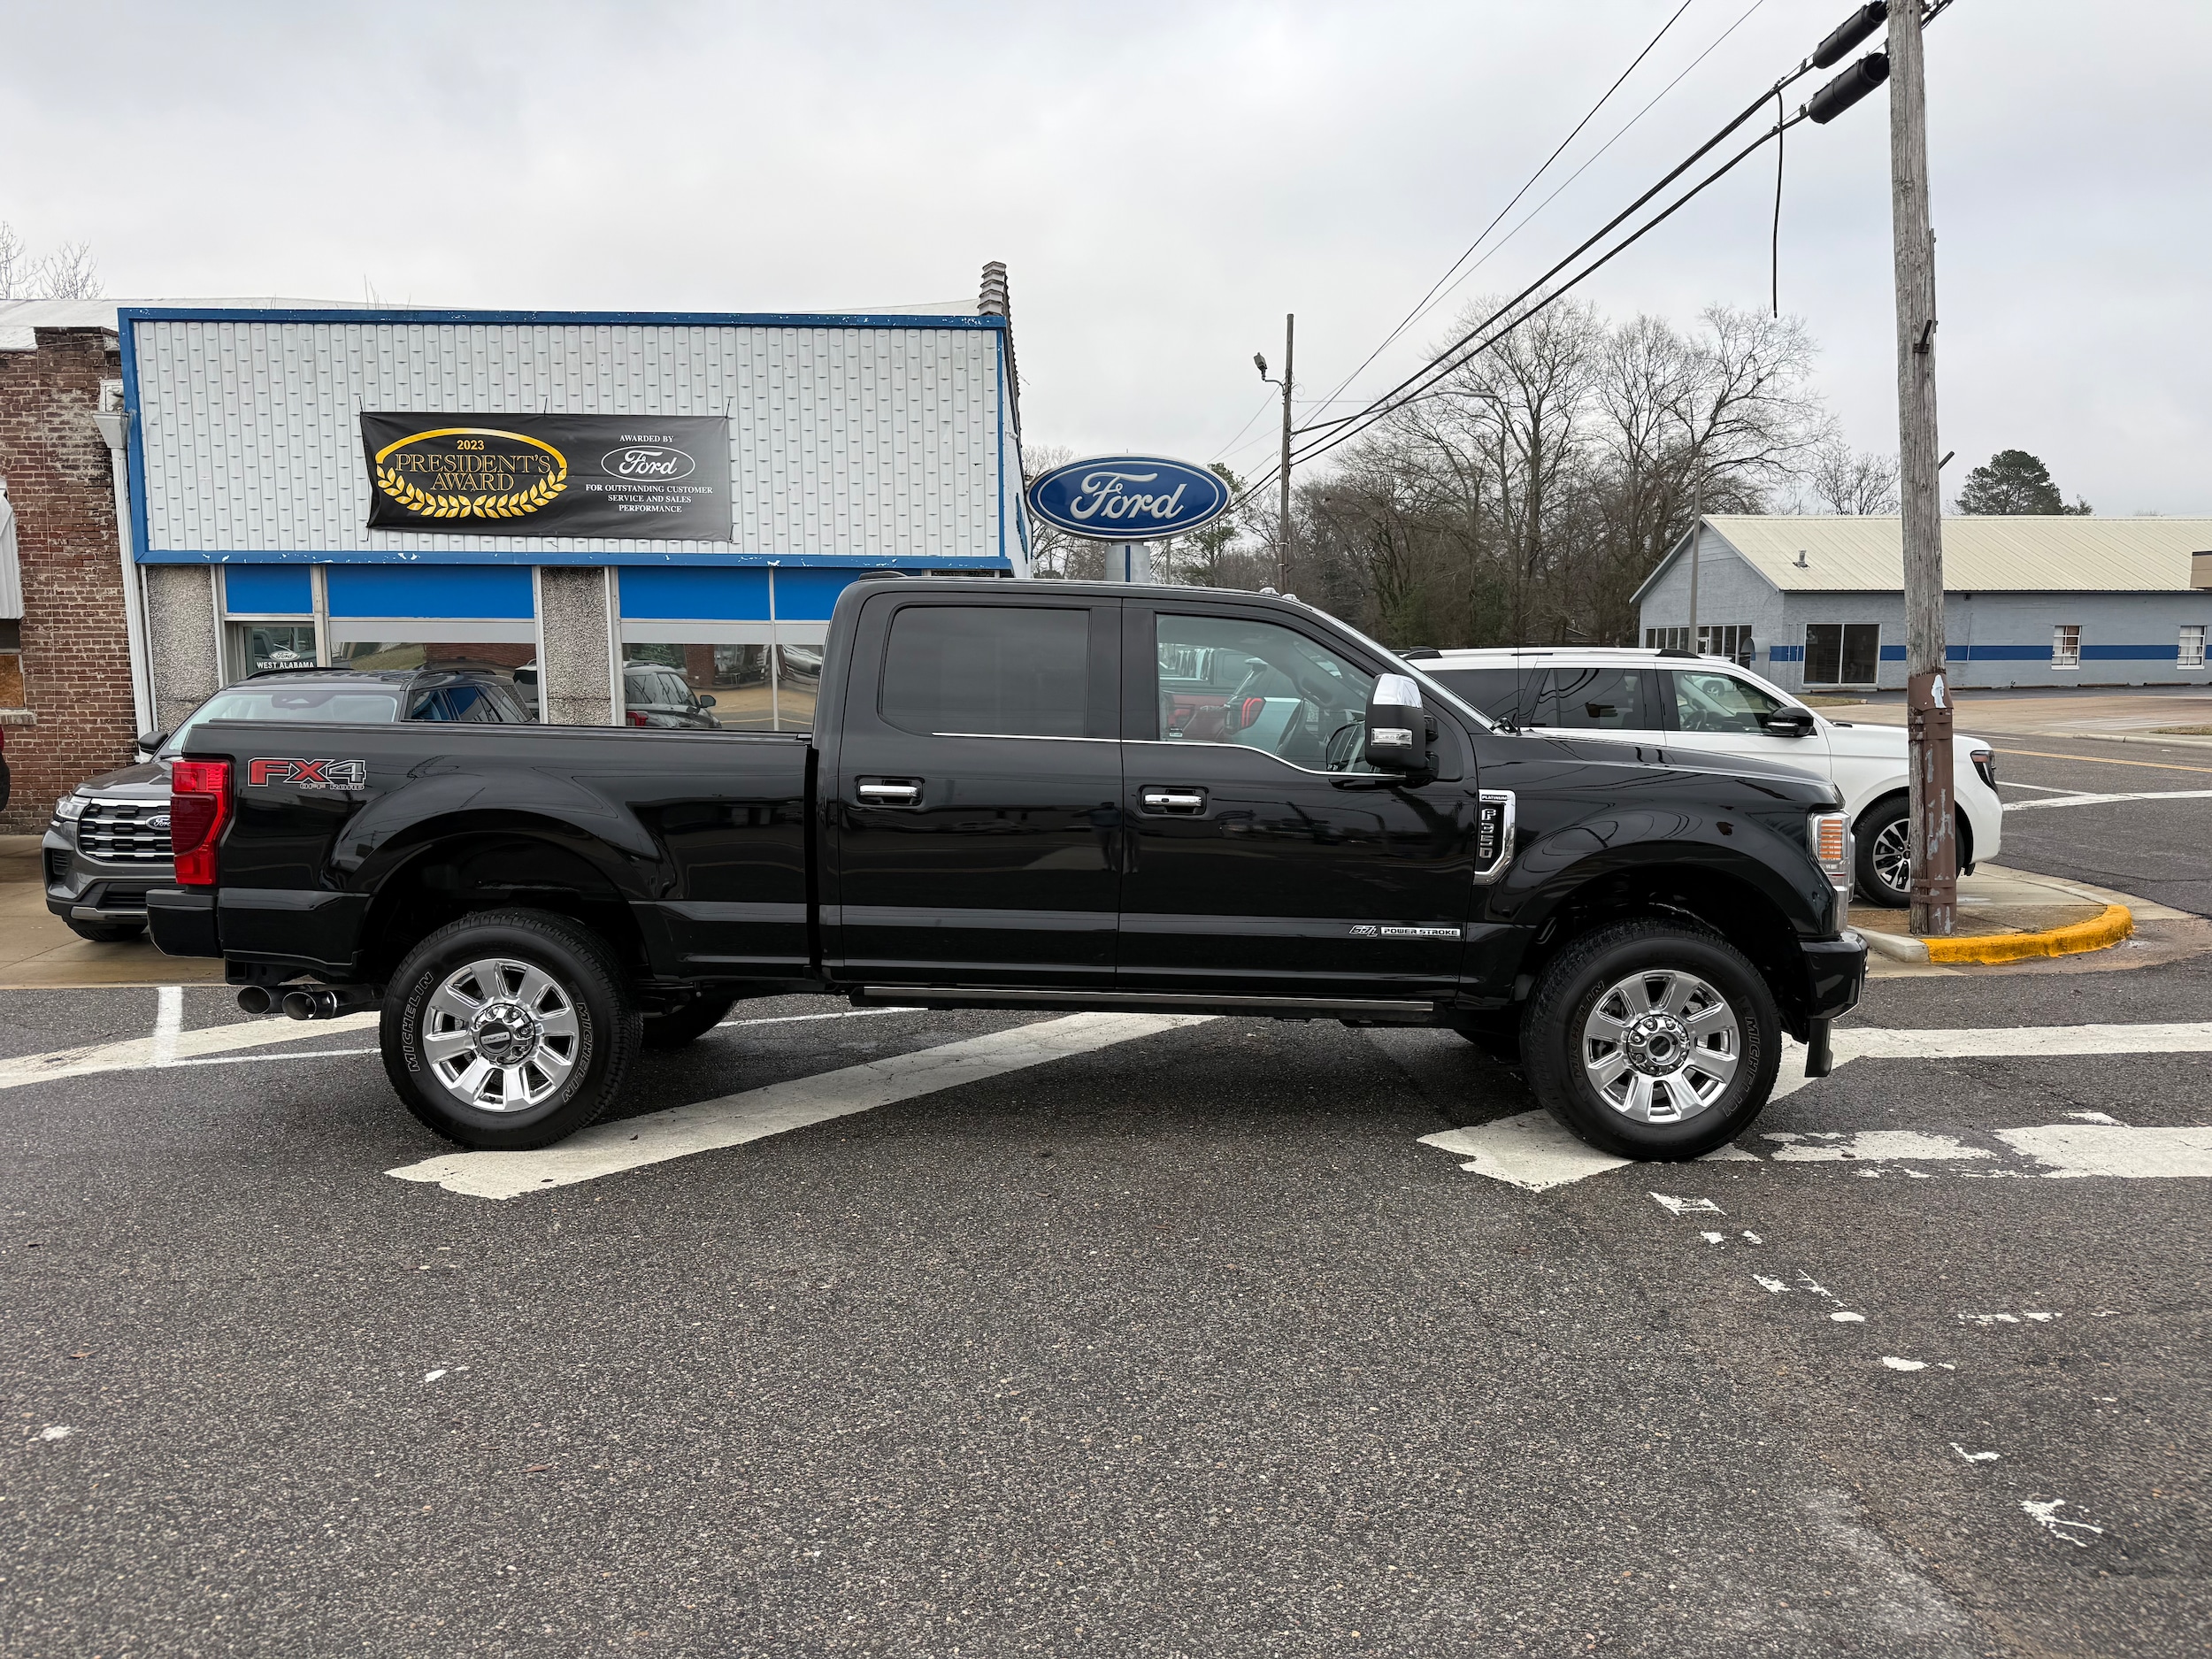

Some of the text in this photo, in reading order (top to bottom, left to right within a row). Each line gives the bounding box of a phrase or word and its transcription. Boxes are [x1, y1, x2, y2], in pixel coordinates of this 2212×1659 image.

[457, 440, 485, 450] 2023
[395, 453, 551, 474] PRESIDENT'S
[618, 449, 678, 475] Ford
[430, 472, 514, 492] AWARD
[604, 484, 665, 493] OUTSTANDING
[1070, 471, 1187, 520] Ford
[618, 504, 683, 513] PERFORMANCE
[248, 757, 367, 787] FX4
[402, 971, 434, 1072] MICHELIN
[1569, 979, 1606, 1080] MICHELIN
[562, 1002, 594, 1105] MICHELIN
[1722, 1017, 1761, 1118] MICHELIN
